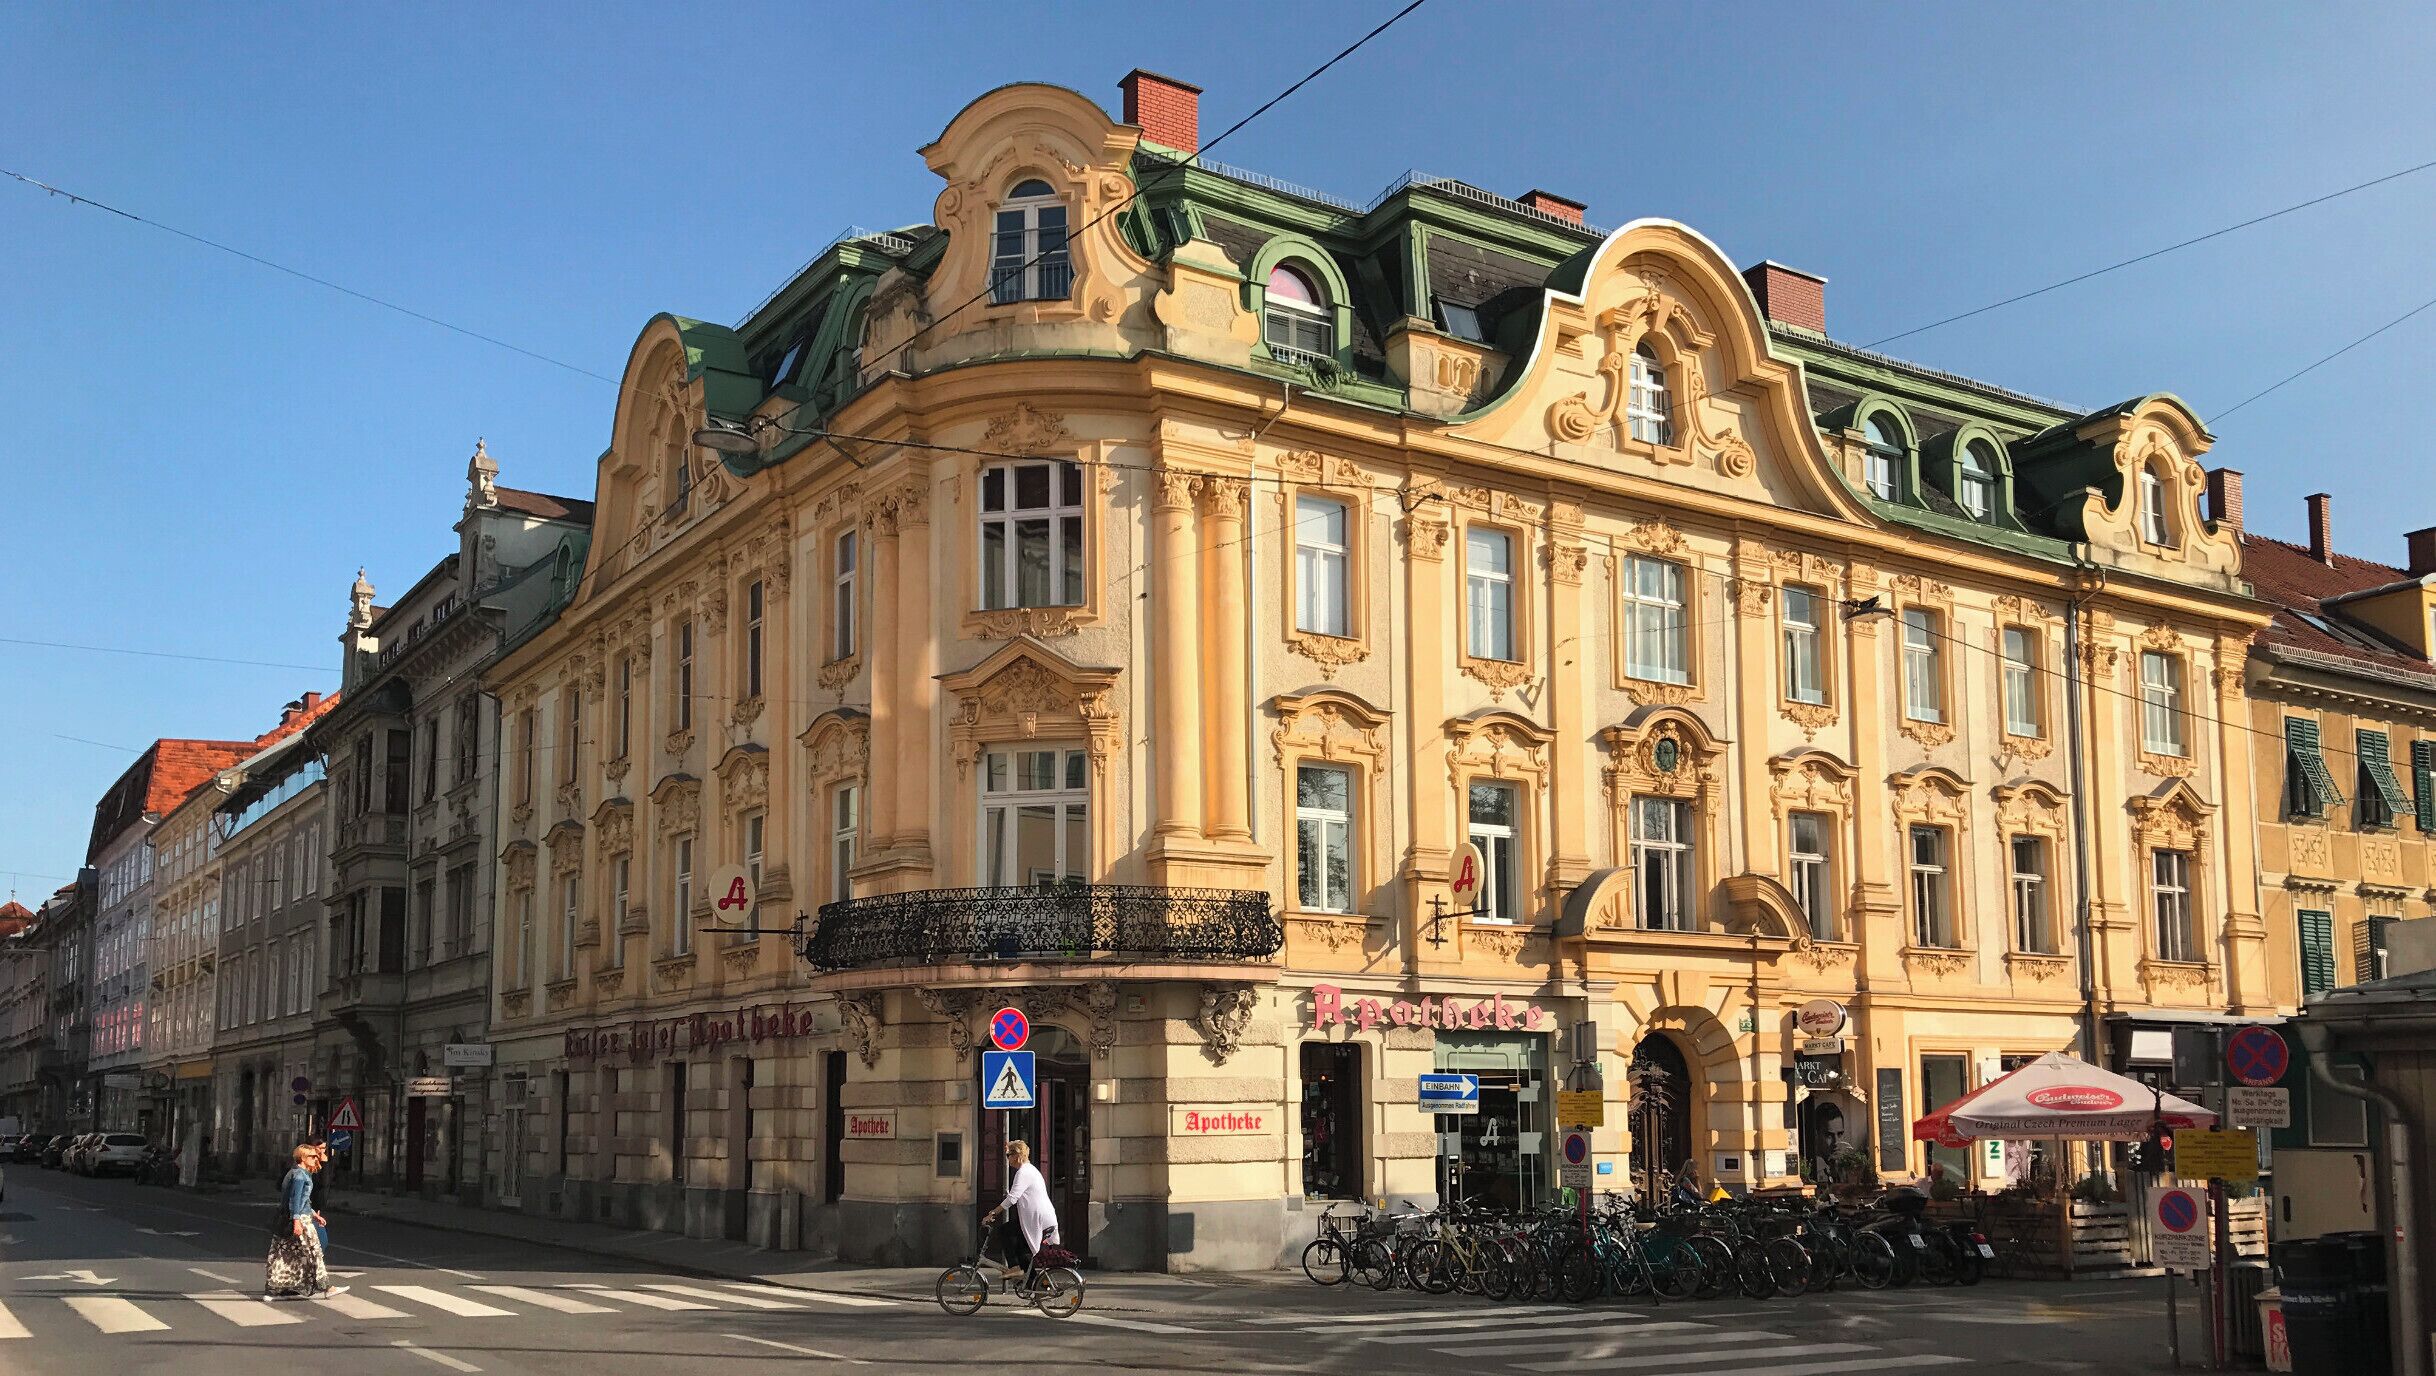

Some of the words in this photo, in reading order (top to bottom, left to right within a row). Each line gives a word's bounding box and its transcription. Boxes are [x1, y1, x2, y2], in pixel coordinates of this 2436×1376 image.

[1454, 856, 1475, 893] A
[717, 876, 749, 911] A
[1311, 984, 1544, 1034] Apotheke
[686, 1000, 814, 1053] Apotheke
[1425, 1082, 1460, 1091] EINBAHN
[849, 1116, 890, 1137] Apotheke
[1185, 1112, 1262, 1134] Apotheke
[1480, 1118, 1500, 1147] A
[1975, 1119, 2020, 1131] Original
[2024, 1119, 2055, 1129] Czech
[2058, 1118, 2107, 1128] Premium
[2110, 1117, 2142, 1129] Lager
